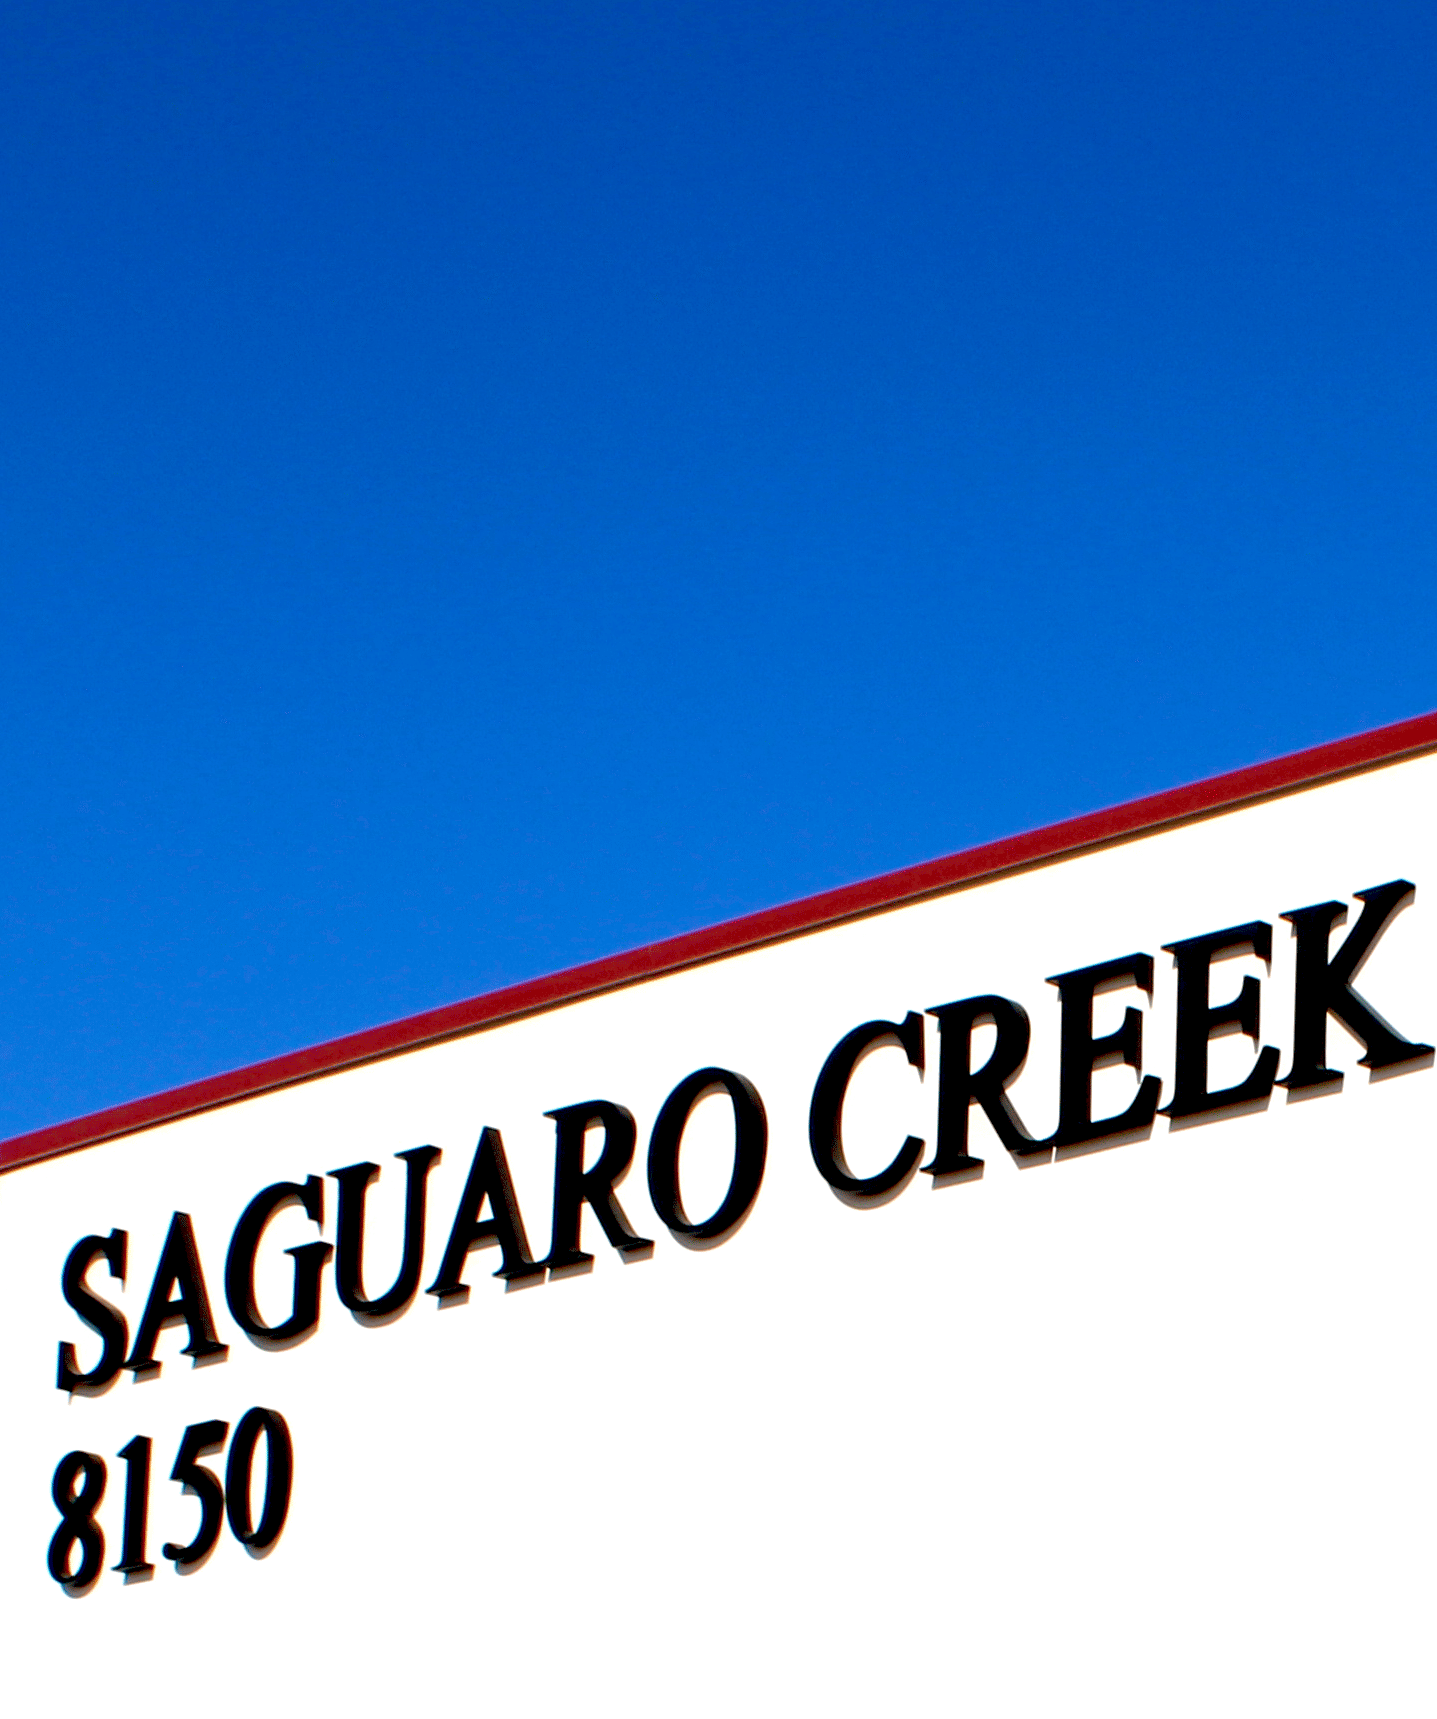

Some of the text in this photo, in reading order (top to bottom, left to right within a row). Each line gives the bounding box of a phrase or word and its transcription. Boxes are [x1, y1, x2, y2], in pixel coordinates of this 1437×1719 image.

[56, 879, 1435, 1392] SAGUARO CREEK
[47, 1407, 294, 1589] 8150
